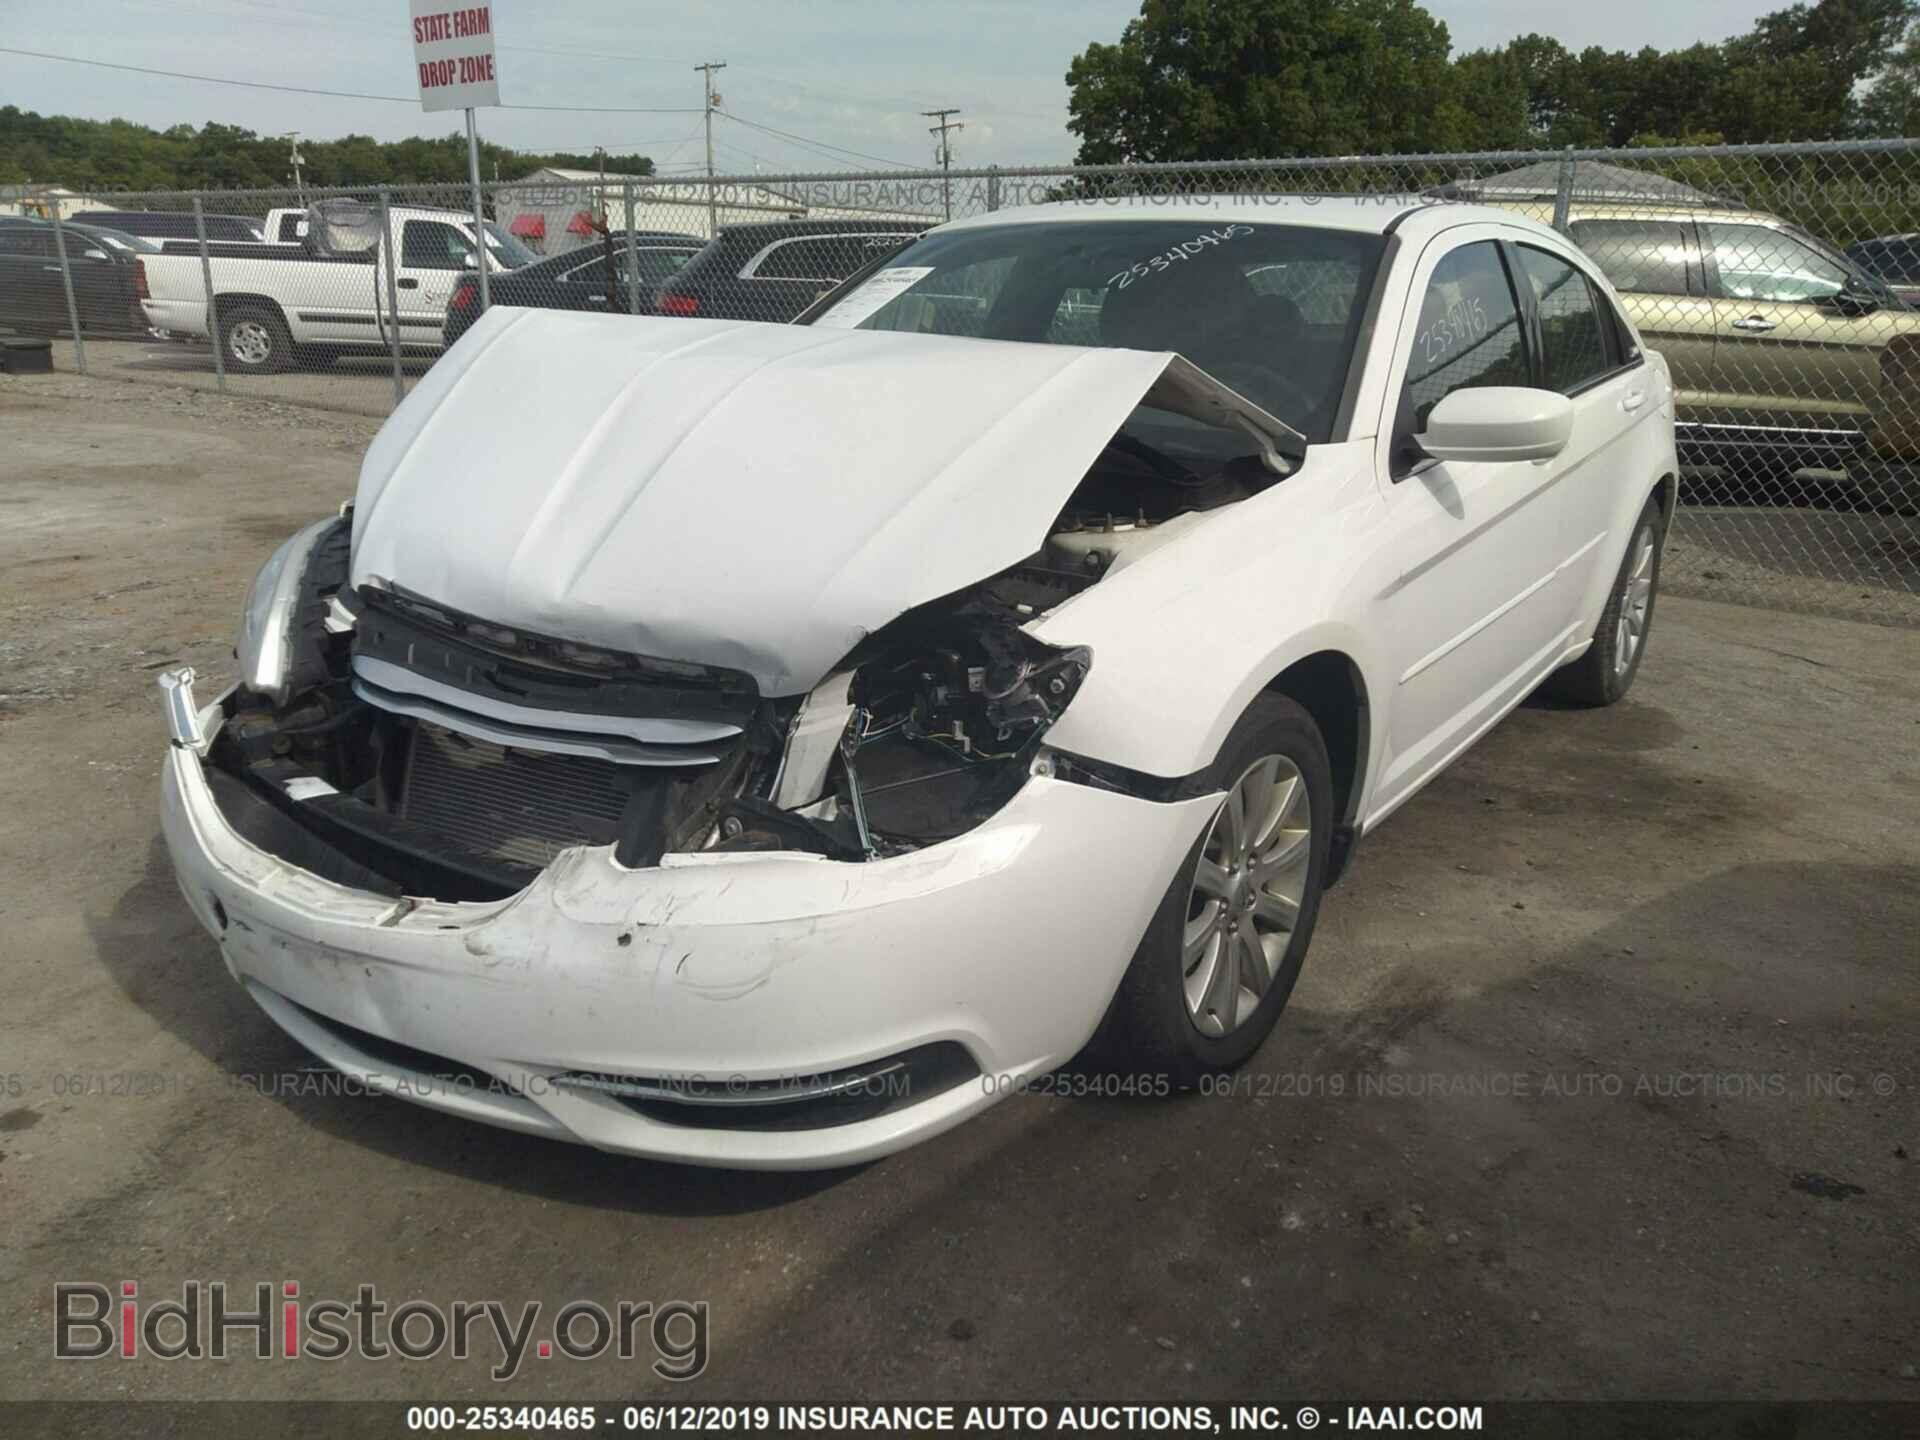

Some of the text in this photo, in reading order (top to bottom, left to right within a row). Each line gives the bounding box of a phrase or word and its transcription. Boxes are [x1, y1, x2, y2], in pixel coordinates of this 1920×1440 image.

[414, 7, 490, 43] STATE FARM
[419, 54, 494, 88] DROP ZONE
[1107, 224, 1254, 289] 25340465
